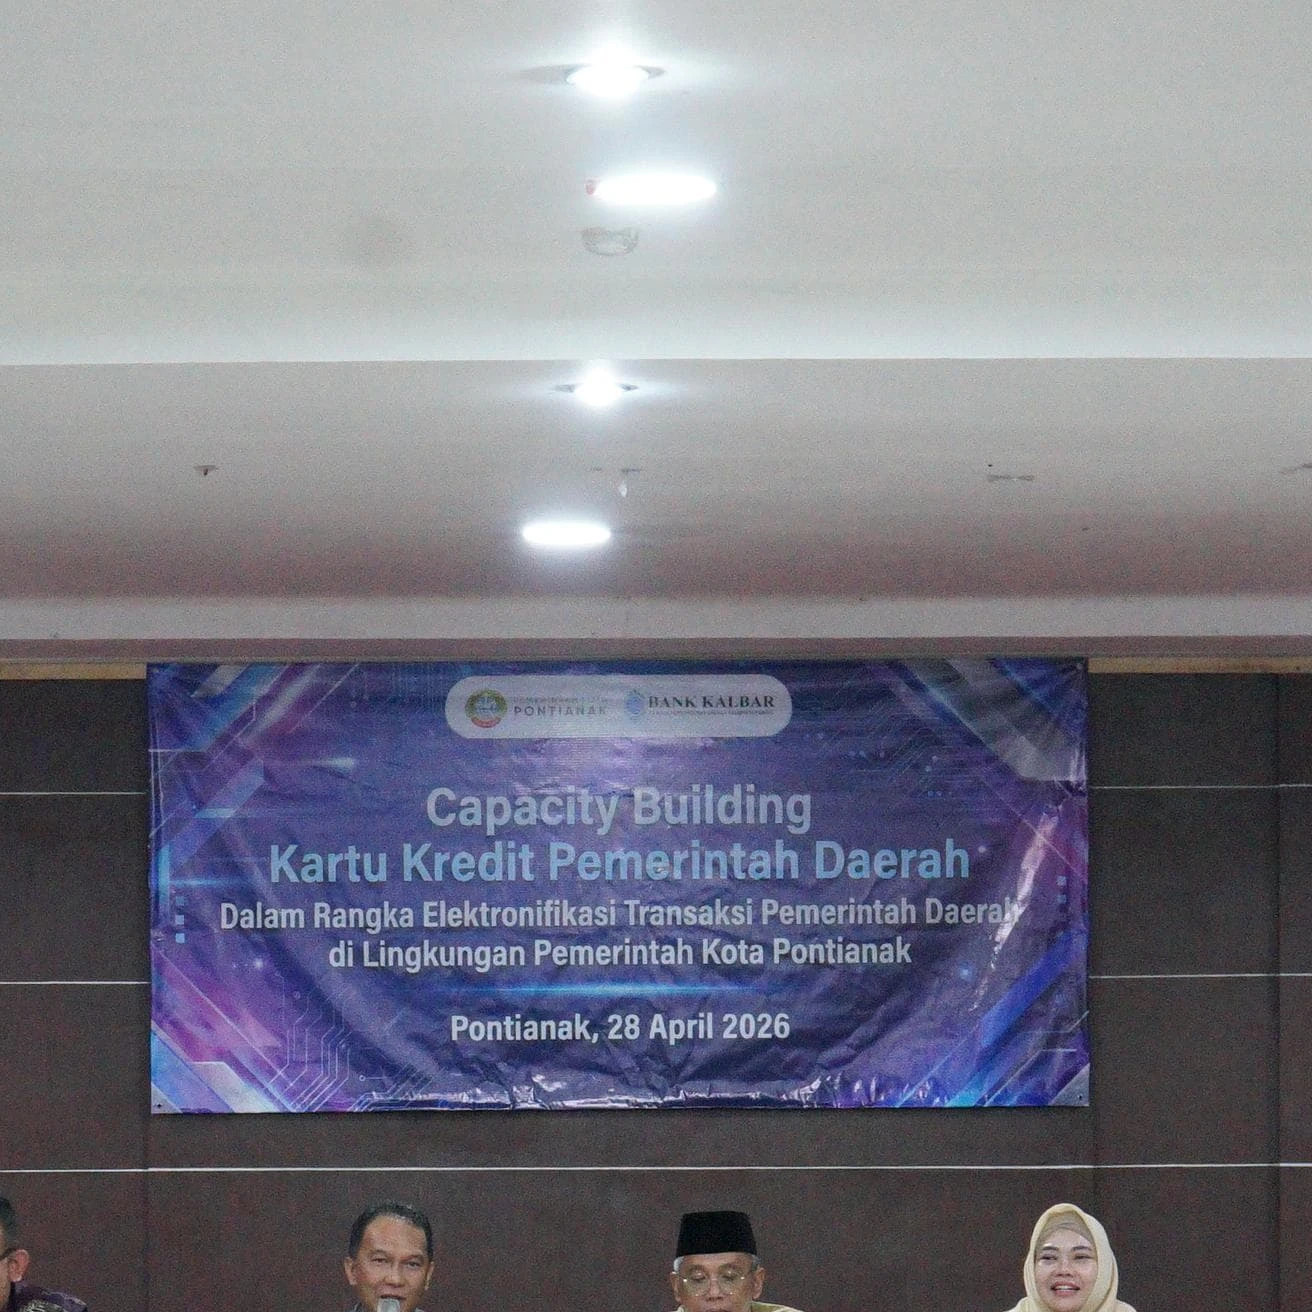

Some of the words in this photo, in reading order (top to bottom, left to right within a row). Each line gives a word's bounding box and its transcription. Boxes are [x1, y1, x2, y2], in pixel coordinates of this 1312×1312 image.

[513, 705, 607, 717] PONTIANAK
[648, 695, 697, 708] BANK
[702, 695, 775, 708] KALBAR
[426, 785, 620, 836] Capacity
[633, 783, 812, 835] Building
[269, 844, 387, 883] Kartu
[402, 840, 534, 882] Kredit
[548, 839, 799, 882] Pemerintah
[814, 838, 970, 881] Daerah
[220, 901, 305, 929] Dalam
[314, 901, 414, 935] Rangka
[422, 899, 616, 928] Elektronifikasi
[624, 898, 753, 926] Transaksi
[761, 897, 917, 925] Pemerintah
[329, 940, 354, 968] di
[362, 940, 526, 974] Lingkungan
[534, 938, 694, 967] Pemerintah
[702, 937, 764, 965] Kota
[773, 936, 912, 964] Pontianak
[450, 1013, 600, 1043] Pontianak,
[607, 1014, 641, 1040] 28
[648, 1011, 714, 1045] April
[722, 1012, 791, 1040] 2026
